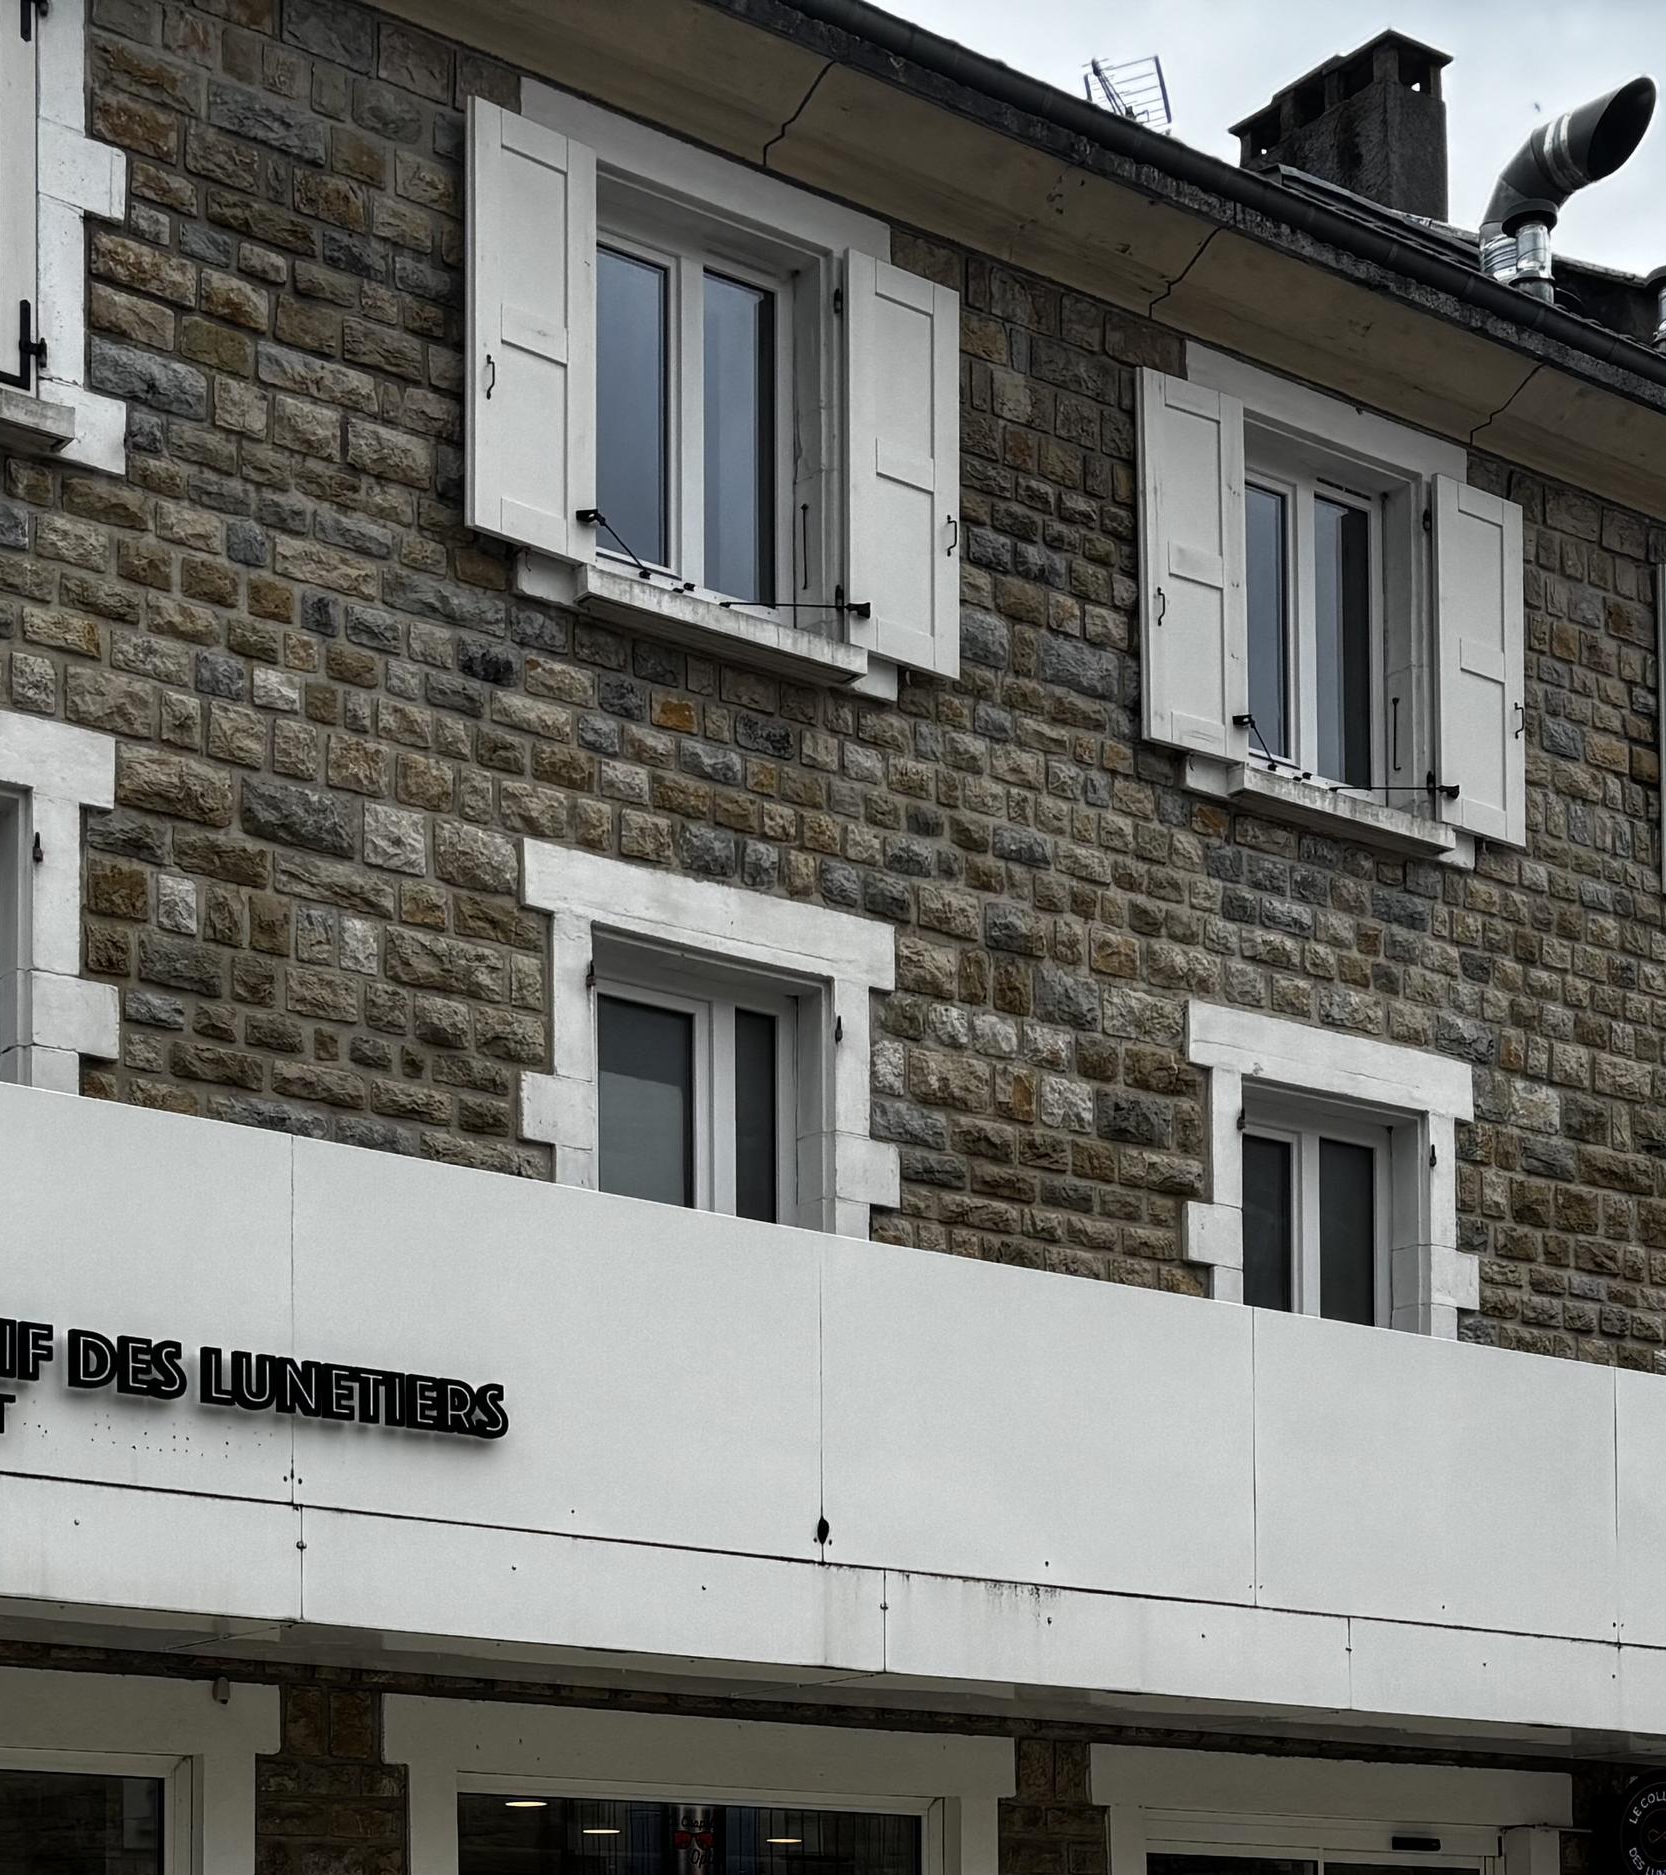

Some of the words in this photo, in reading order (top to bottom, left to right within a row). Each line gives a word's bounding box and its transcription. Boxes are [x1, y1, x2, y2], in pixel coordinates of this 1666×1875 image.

[68, 1329, 187, 1400] DES
[199, 1346, 509, 1439] LUNETIERS
[1629, 1806, 1642, 1824] LE
[1629, 1847, 1645, 1870] DES
